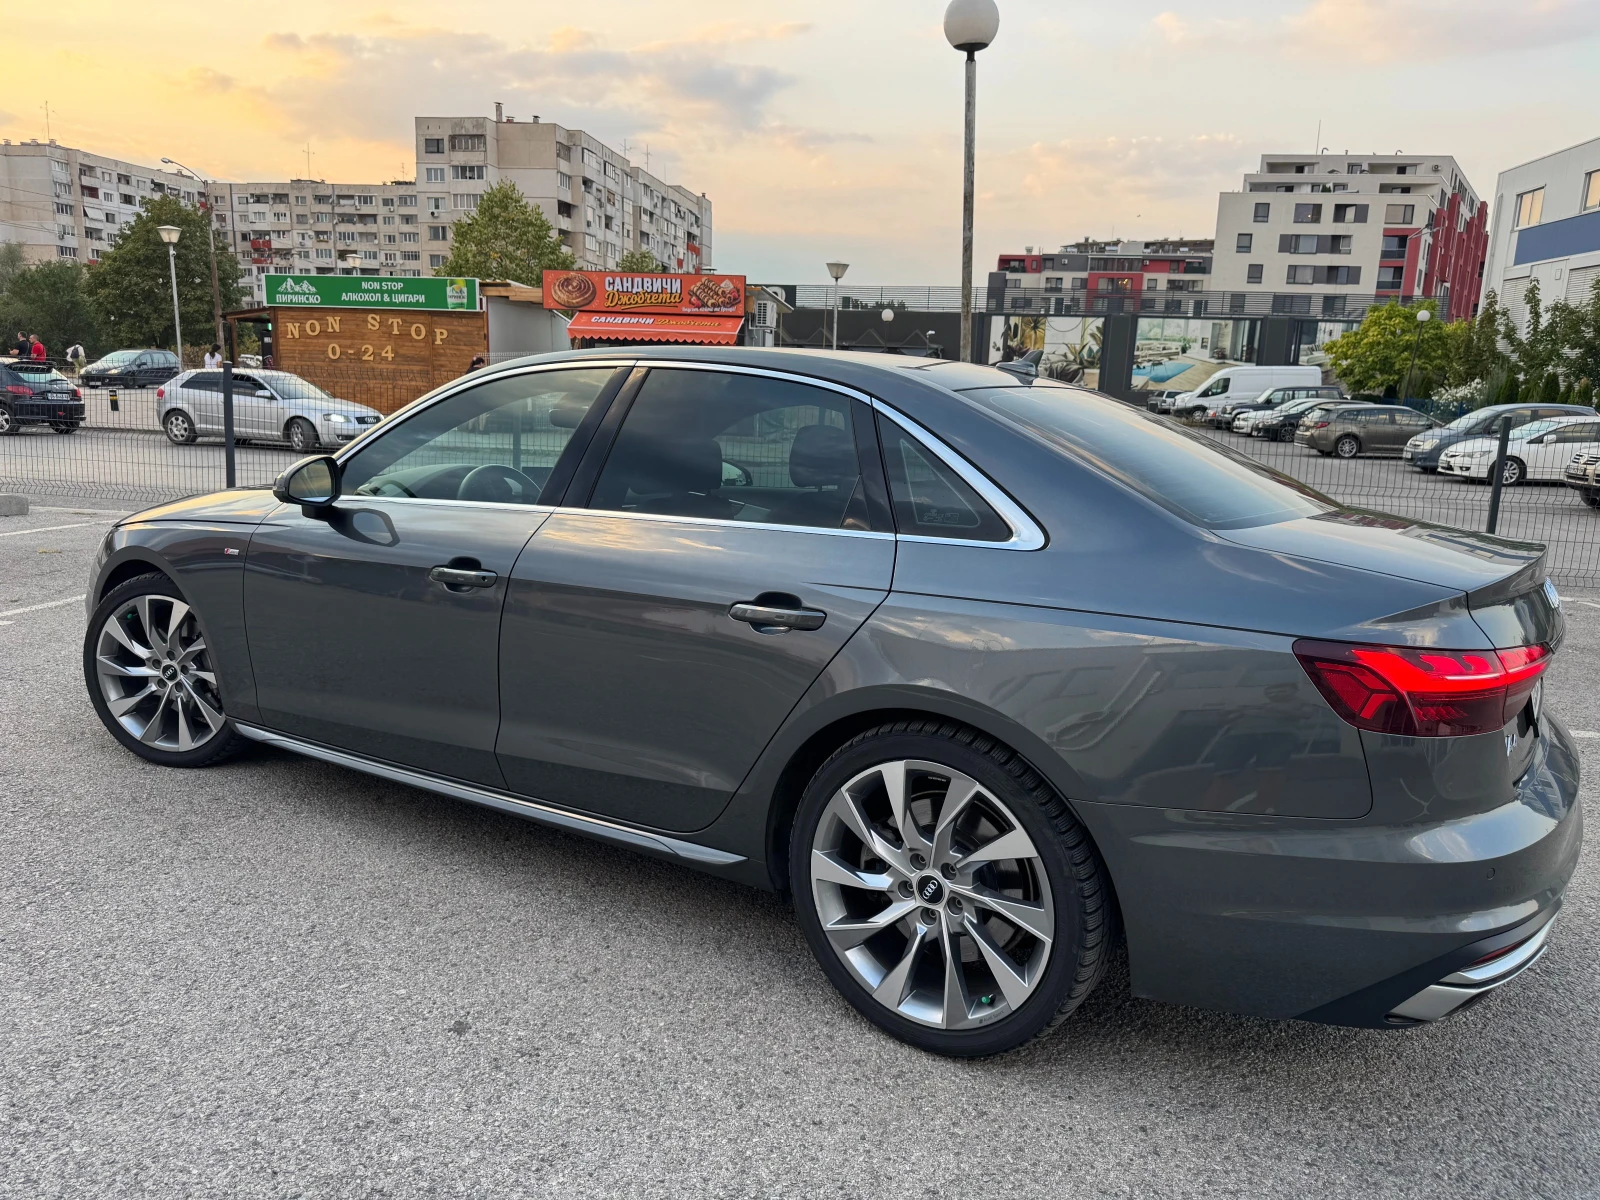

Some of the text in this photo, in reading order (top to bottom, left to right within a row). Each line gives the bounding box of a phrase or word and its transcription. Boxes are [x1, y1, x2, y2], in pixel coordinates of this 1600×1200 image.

[361, 281, 404, 290] NON STOP
[605, 277, 681, 293] САНДВИЧИ
[276, 294, 321, 304] ПИРИНСКО
[341, 292, 425, 303] АЛКОХОЛ & ЦИГАРИ
[604, 290, 682, 308] Джобчета
[591, 316, 654, 325] САНДВИЧИ
[286, 314, 448, 345] NON STOP
[327, 343, 395, 361] 0-24
